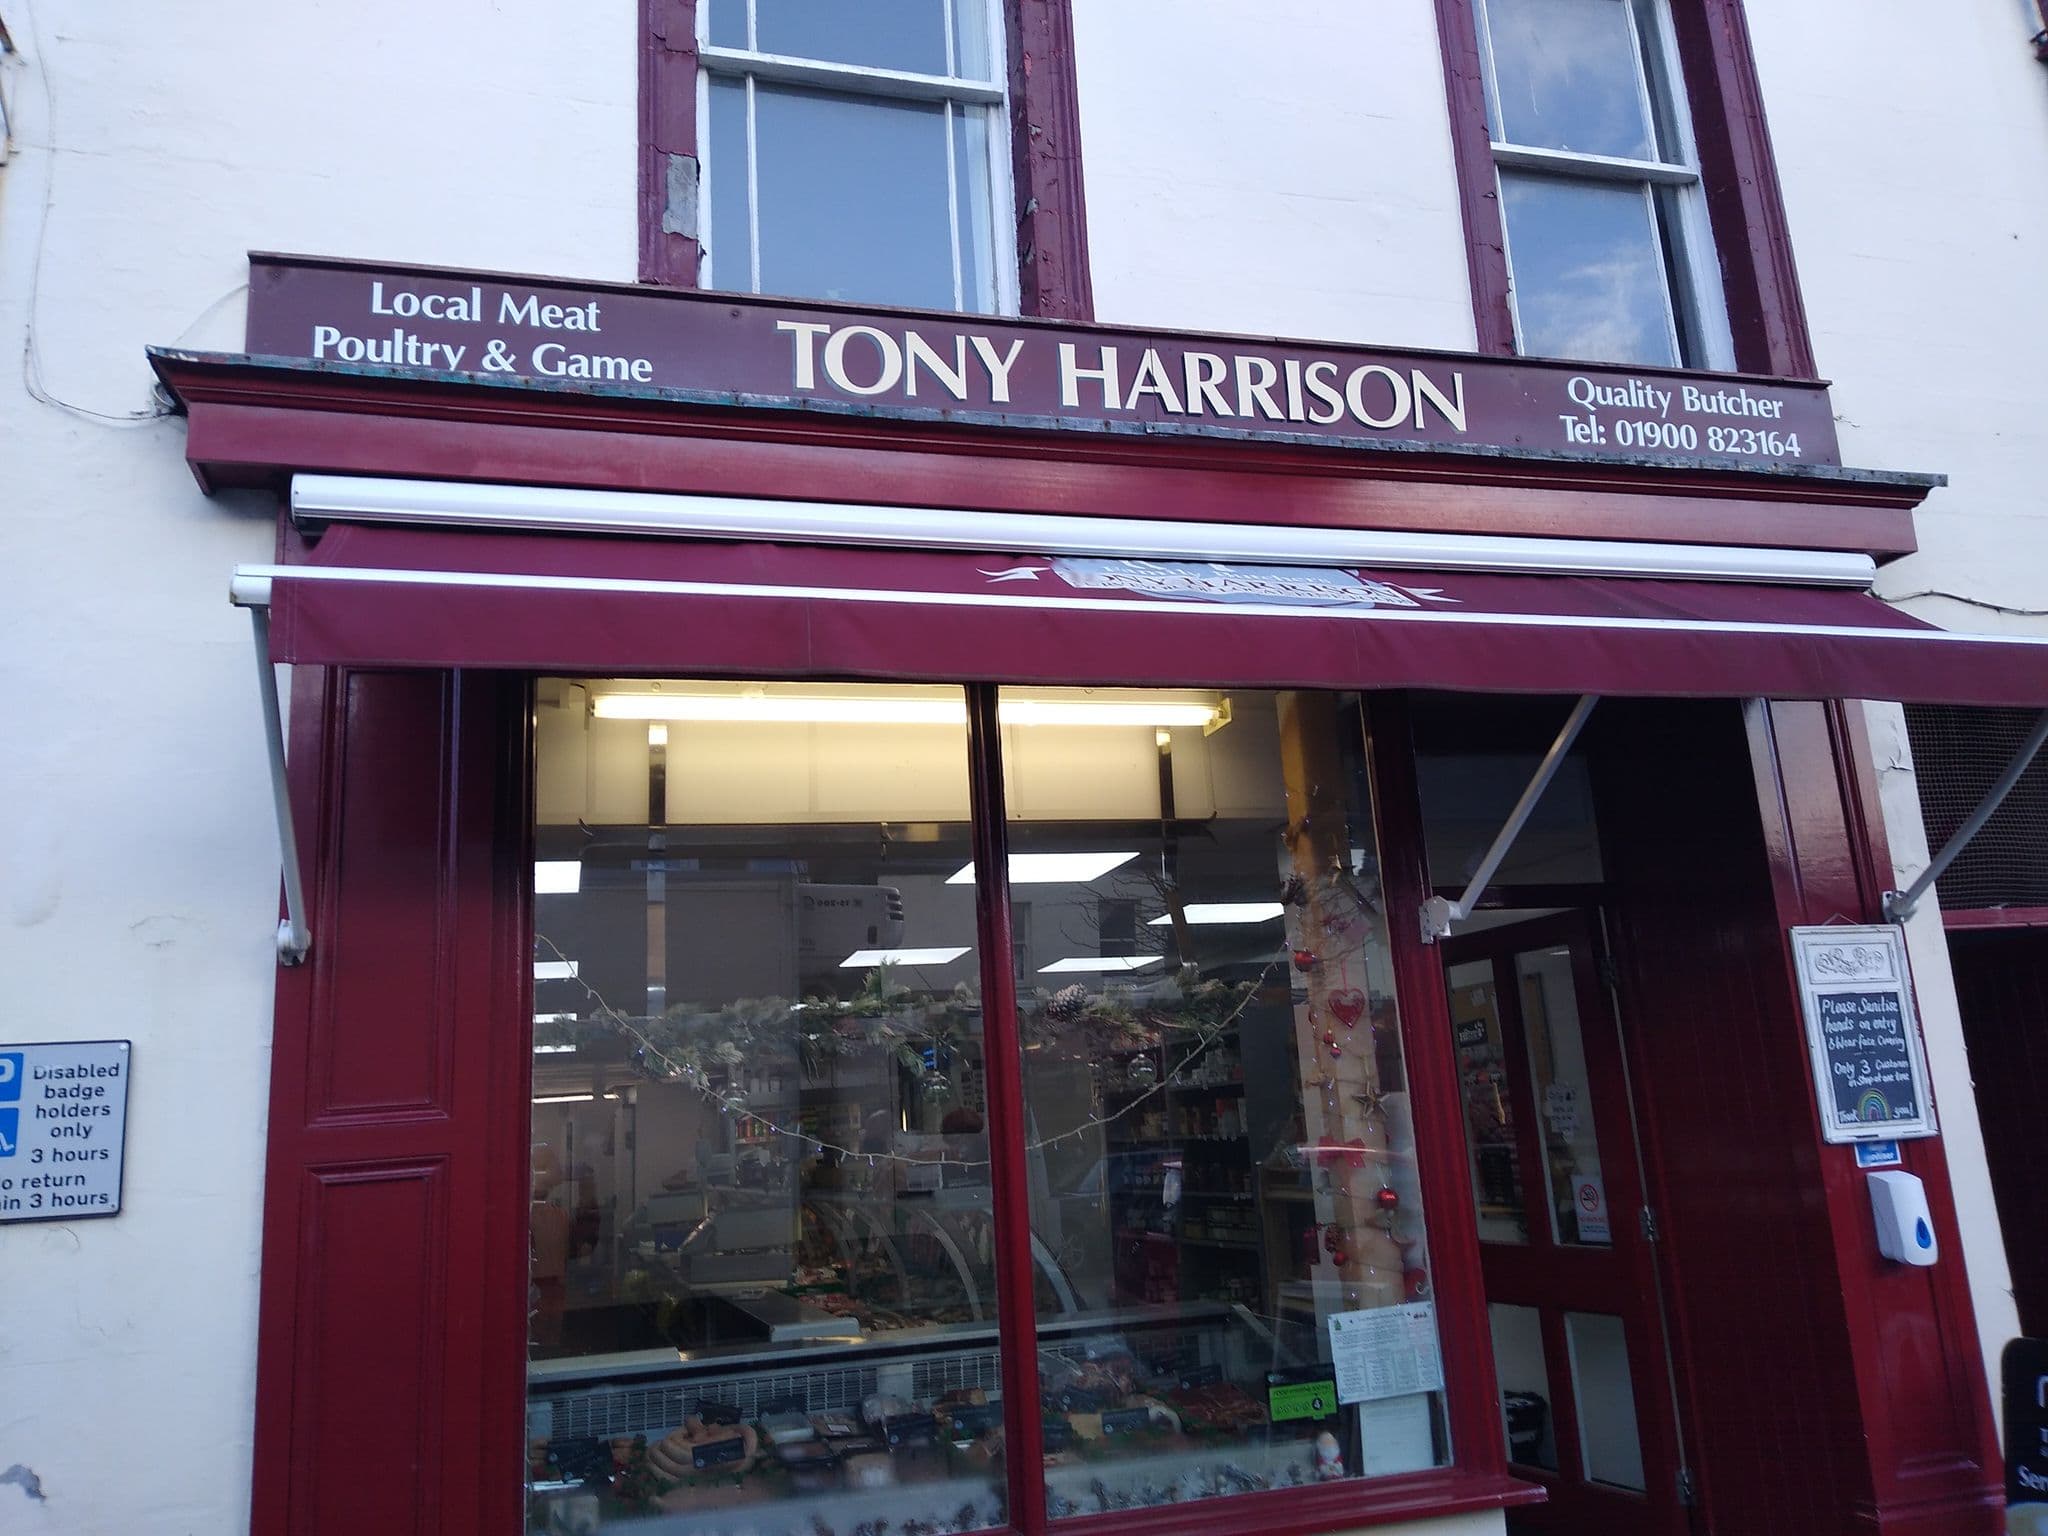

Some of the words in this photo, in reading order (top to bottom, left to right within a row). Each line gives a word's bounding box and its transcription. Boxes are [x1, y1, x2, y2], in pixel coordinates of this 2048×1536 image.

[371, 281, 482, 321] Local
[499, 294, 602, 332] Meat
[312, 325, 466, 372] Poultry
[481, 339, 517, 374] &
[532, 343, 653, 382] Game
[775, 319, 1025, 402] TONY
[1058, 342, 1467, 432] HARRISON
[1567, 376, 1672, 418] Quality
[1681, 385, 1783, 419] Butcher
[1559, 415, 1607, 445] Tel:
[1615, 419, 1698, 450] 01900
[1707, 426, 1801, 458] 823164
[1822, 999, 1857, 1014] Please
[1858, 996, 1898, 1014] Sanitise
[1825, 1016, 1854, 1033] hands
[1859, 1020, 1871, 1031] on
[1873, 1016, 1896, 1034] entry
[33, 1063, 120, 1080] Disabled
[1834, 1062, 1855, 1080] Only
[1860, 1059, 1871, 1074] 3
[44, 1084, 105, 1100] badge
[35, 1104, 111, 1119] holders
[51, 1122, 93, 1139] only
[31, 1149, 43, 1163] 3
[52, 1148, 109, 1162] hours
[0, 1178, 13, 1190] o
[21, 1172, 86, 1189] return
[29, 1193, 42, 1208] 3
[51, 1191, 109, 1207] hours
